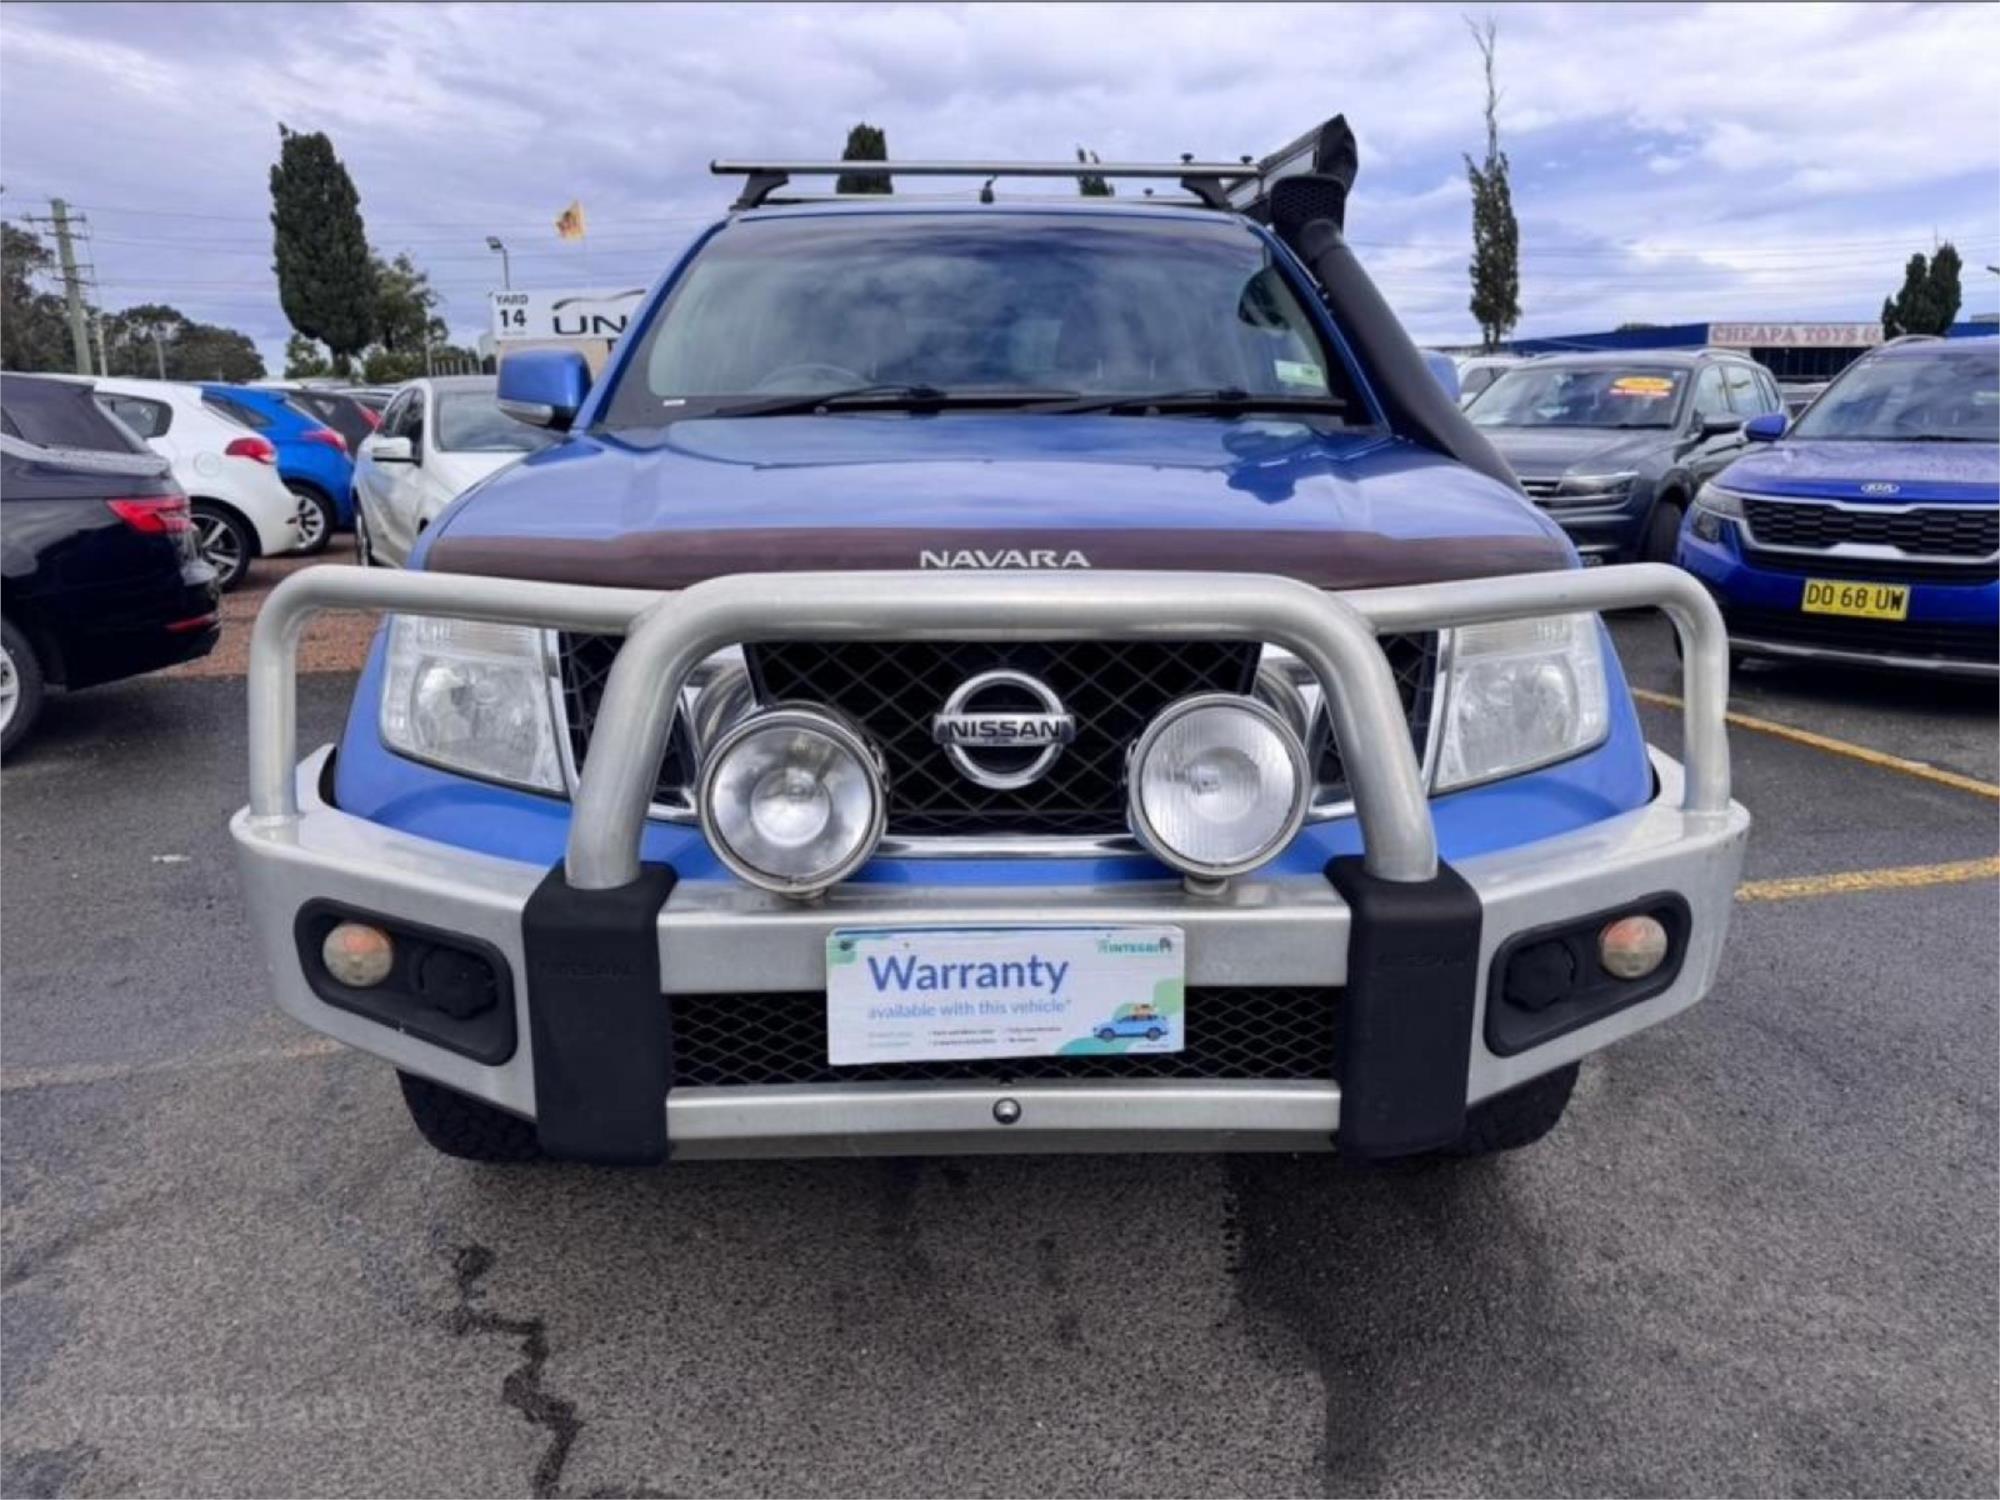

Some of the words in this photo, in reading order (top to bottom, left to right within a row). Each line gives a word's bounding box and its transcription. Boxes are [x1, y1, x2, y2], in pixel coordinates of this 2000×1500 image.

[495, 294, 529, 306] YARD
[500, 308, 527, 328] 14
[1712, 326, 1797, 343] CHEAPA
[1803, 326, 1859, 342] TOYS
[919, 549, 1092, 568] NAVARA
[1840, 586, 1868, 609] 68
[1875, 588, 1905, 612] UW
[948, 720, 1060, 738] NISSAN
[867, 954, 1069, 994] Warranty
[867, 1002, 936, 1020] available
[940, 1000, 975, 1017] with
[979, 1000, 1008, 1015] this
